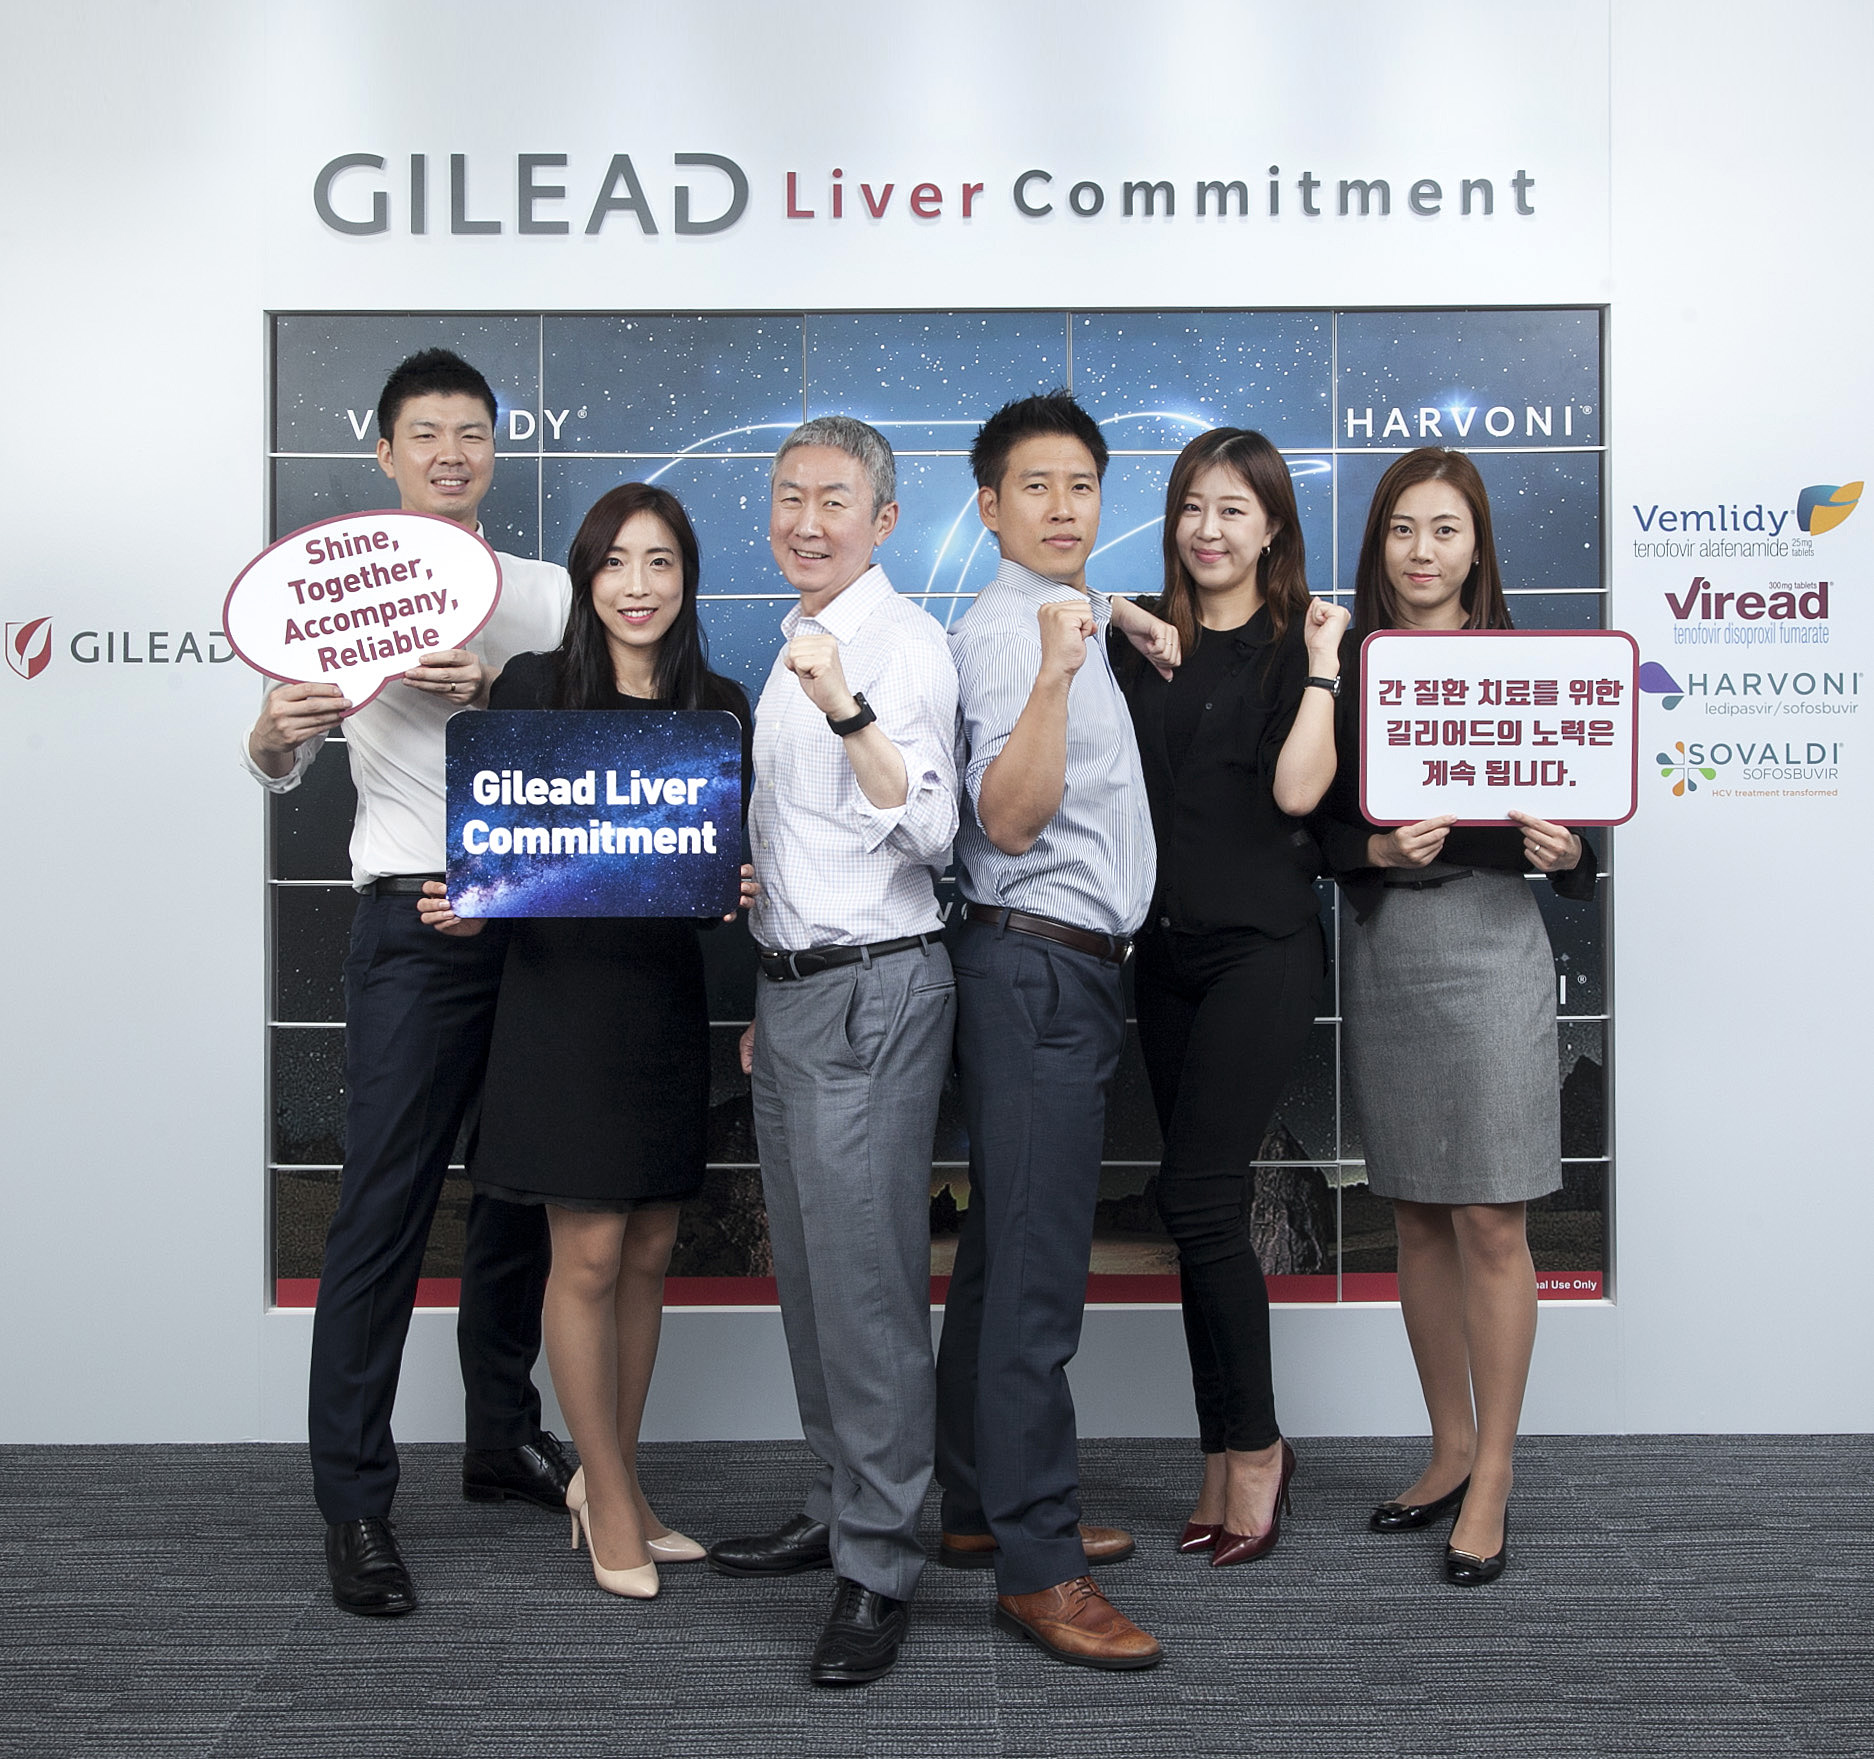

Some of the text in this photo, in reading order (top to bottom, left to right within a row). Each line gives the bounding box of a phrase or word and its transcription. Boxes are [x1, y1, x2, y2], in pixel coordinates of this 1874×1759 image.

[313, 152, 1536, 235] GILEAD Liver Commitment
[1633, 504, 1788, 537] Vemlidy
[304, 529, 402, 566] Shine,
[1633, 538, 1789, 557] tenofovir alafenamide
[1791, 547, 1815, 557] tablets
[288, 555, 434, 606] Together,
[1793, 581, 1818, 589] tablets
[1664, 577, 1829, 620] Viread
[284, 586, 459, 645] Accompany,
[70, 630, 236, 664] GILEAD
[1673, 622, 1829, 648] tenofovir disoproxil fumarate
[317, 626, 440, 673] Reliable
[1378, 678, 1624, 706] 간 질환 치료를 위한
[1688, 673, 1858, 696] HARVONI
[1705, 702, 1858, 716] ledipasvir/sofosbuvir
[1387, 720, 1615, 746] 길리어드의 노력은
[1688, 743, 1838, 765] SOVALDI
[1422, 760, 1577, 786] 계속 됩니다.
[1743, 768, 1838, 780] SOFOSBUVIR
[472, 769, 708, 806] Gilead Liver
[1712, 788, 1838, 797] HCV treatment transformed
[462, 820, 717, 854] Commitment
[1551, 1280, 1571, 1289] Use
[1573, 1280, 1597, 1291] Only
